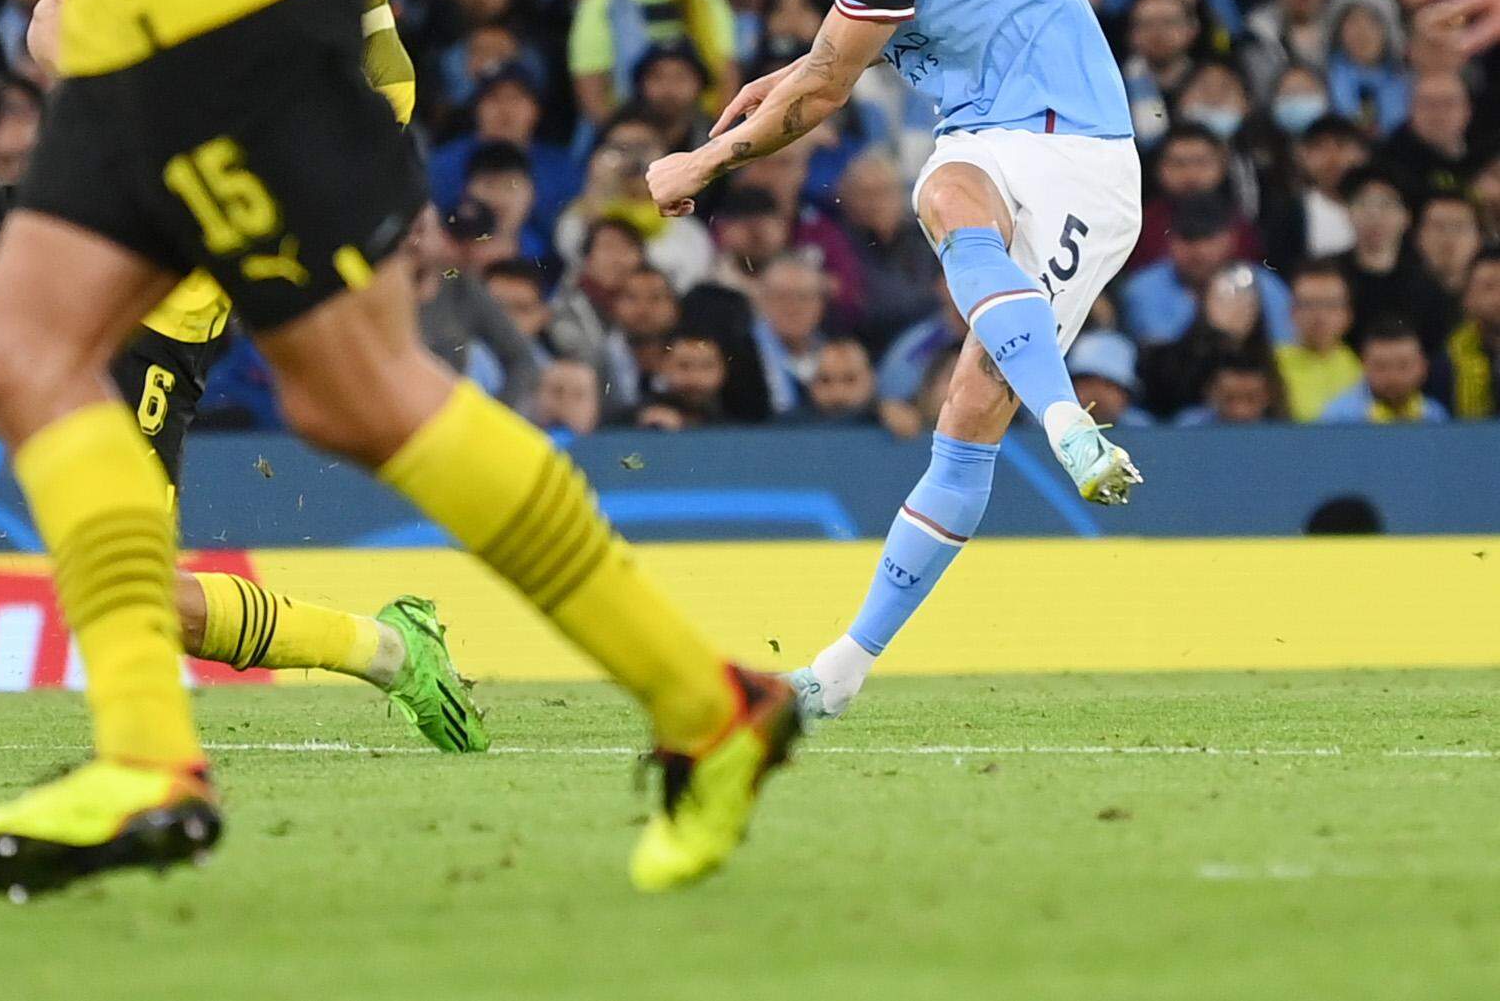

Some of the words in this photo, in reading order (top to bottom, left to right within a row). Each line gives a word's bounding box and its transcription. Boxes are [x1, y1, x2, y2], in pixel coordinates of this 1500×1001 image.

[164, 136, 277, 254] 15
[1048, 213, 1089, 281] 5
[995, 332, 1031, 362] CITY
[137, 363, 176, 437] 6
[884, 557, 921, 585] CITY
